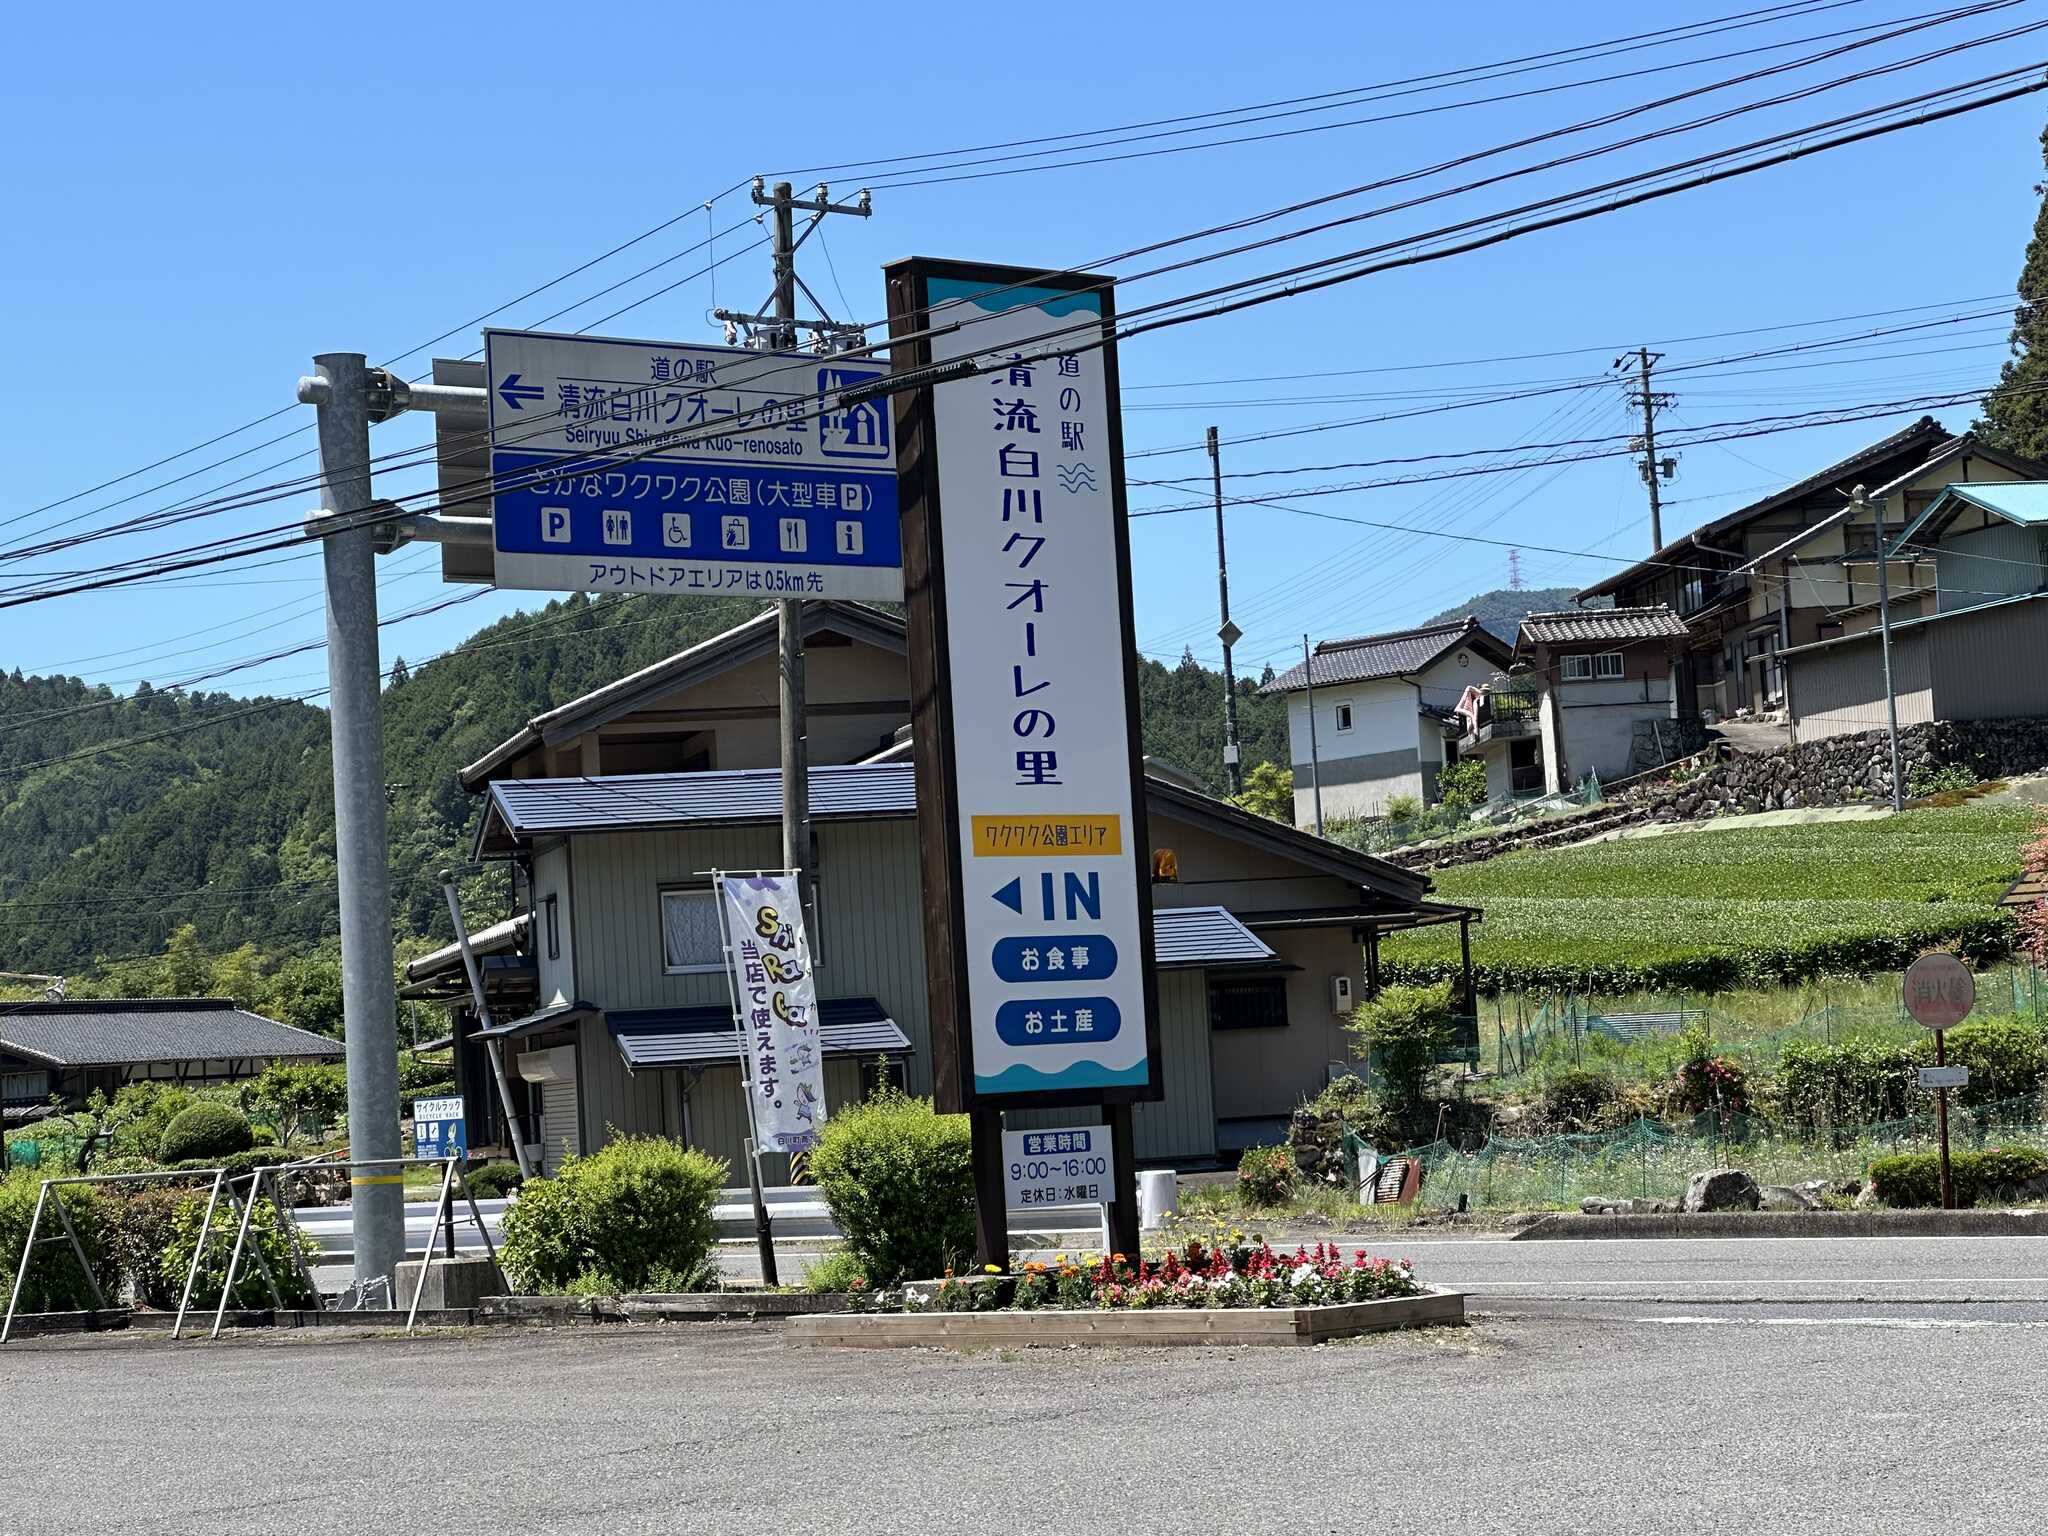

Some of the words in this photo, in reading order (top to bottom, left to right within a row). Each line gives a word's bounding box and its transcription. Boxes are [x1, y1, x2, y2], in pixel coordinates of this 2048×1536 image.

[651, 356, 717, 385] 道の駅
[557, 383, 808, 432] 清流白川クオーレの里
[1057, 347, 1085, 451] 道の駅
[565, 424, 620, 447] Seiryuu
[589, 564, 824, 593] アウトドアエリアは0.5km先
[990, 352, 1062, 786] 清流白川クオーレの里
[986, 823, 1108, 848] ワクワク公園エリア
[1041, 871, 1101, 921] IN
[1021, 945, 1090, 971] お食事
[741, 938, 783, 1109] 当店で使えます。
[1024, 1009, 1094, 1034] お土産
[416, 1100, 460, 1112] サイクルラック
[1028, 1133, 1086, 1153] 営業時間
[1020, 1184, 1099, 1204] 定休日:水曜日
